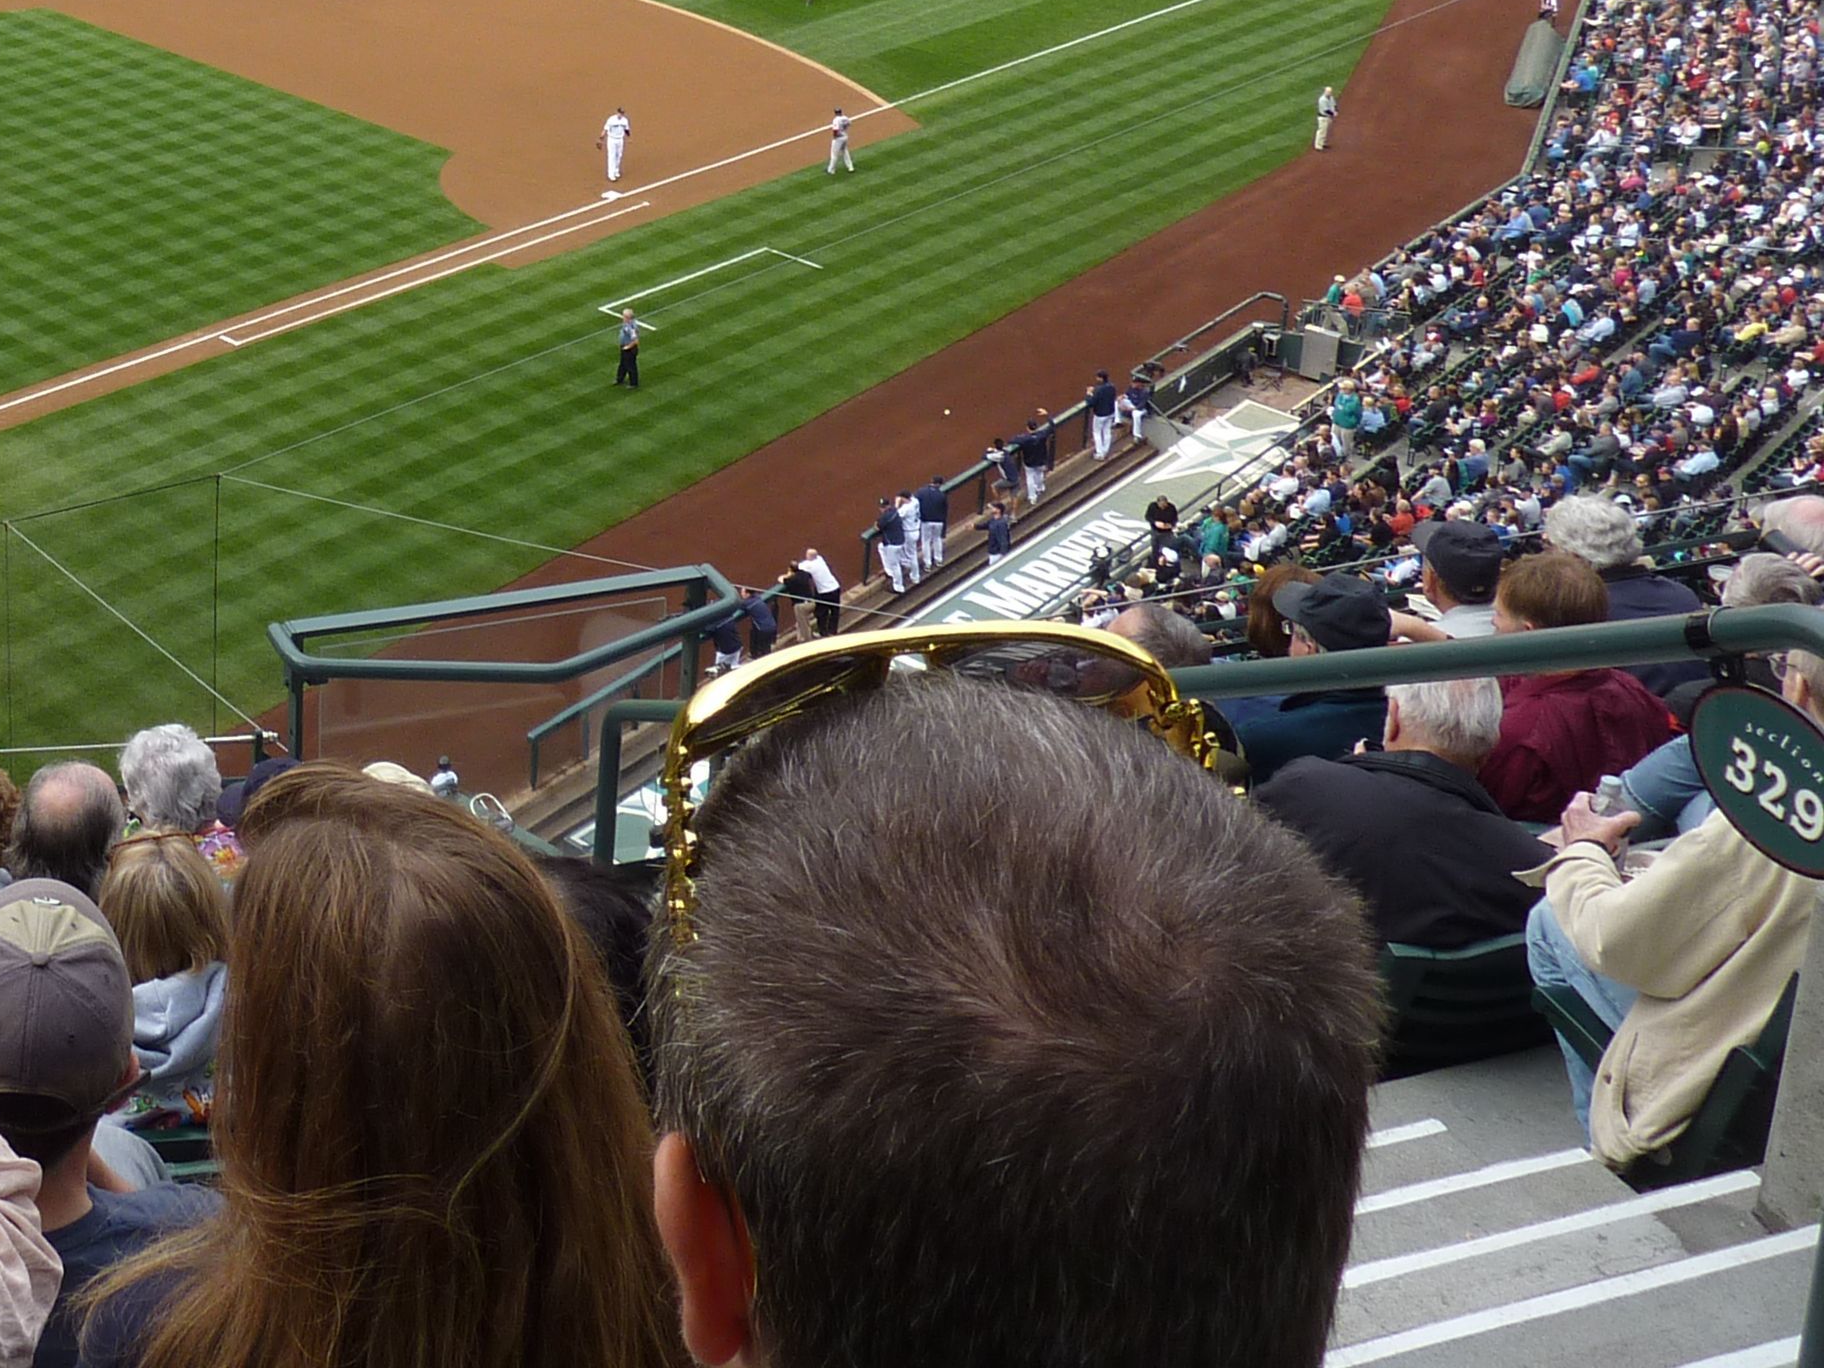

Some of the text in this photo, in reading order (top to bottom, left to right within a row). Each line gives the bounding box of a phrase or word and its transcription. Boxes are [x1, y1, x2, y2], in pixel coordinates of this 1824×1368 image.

[963, 509, 1151, 621] MARINERS
[1726, 722, 1824, 842] section 329
